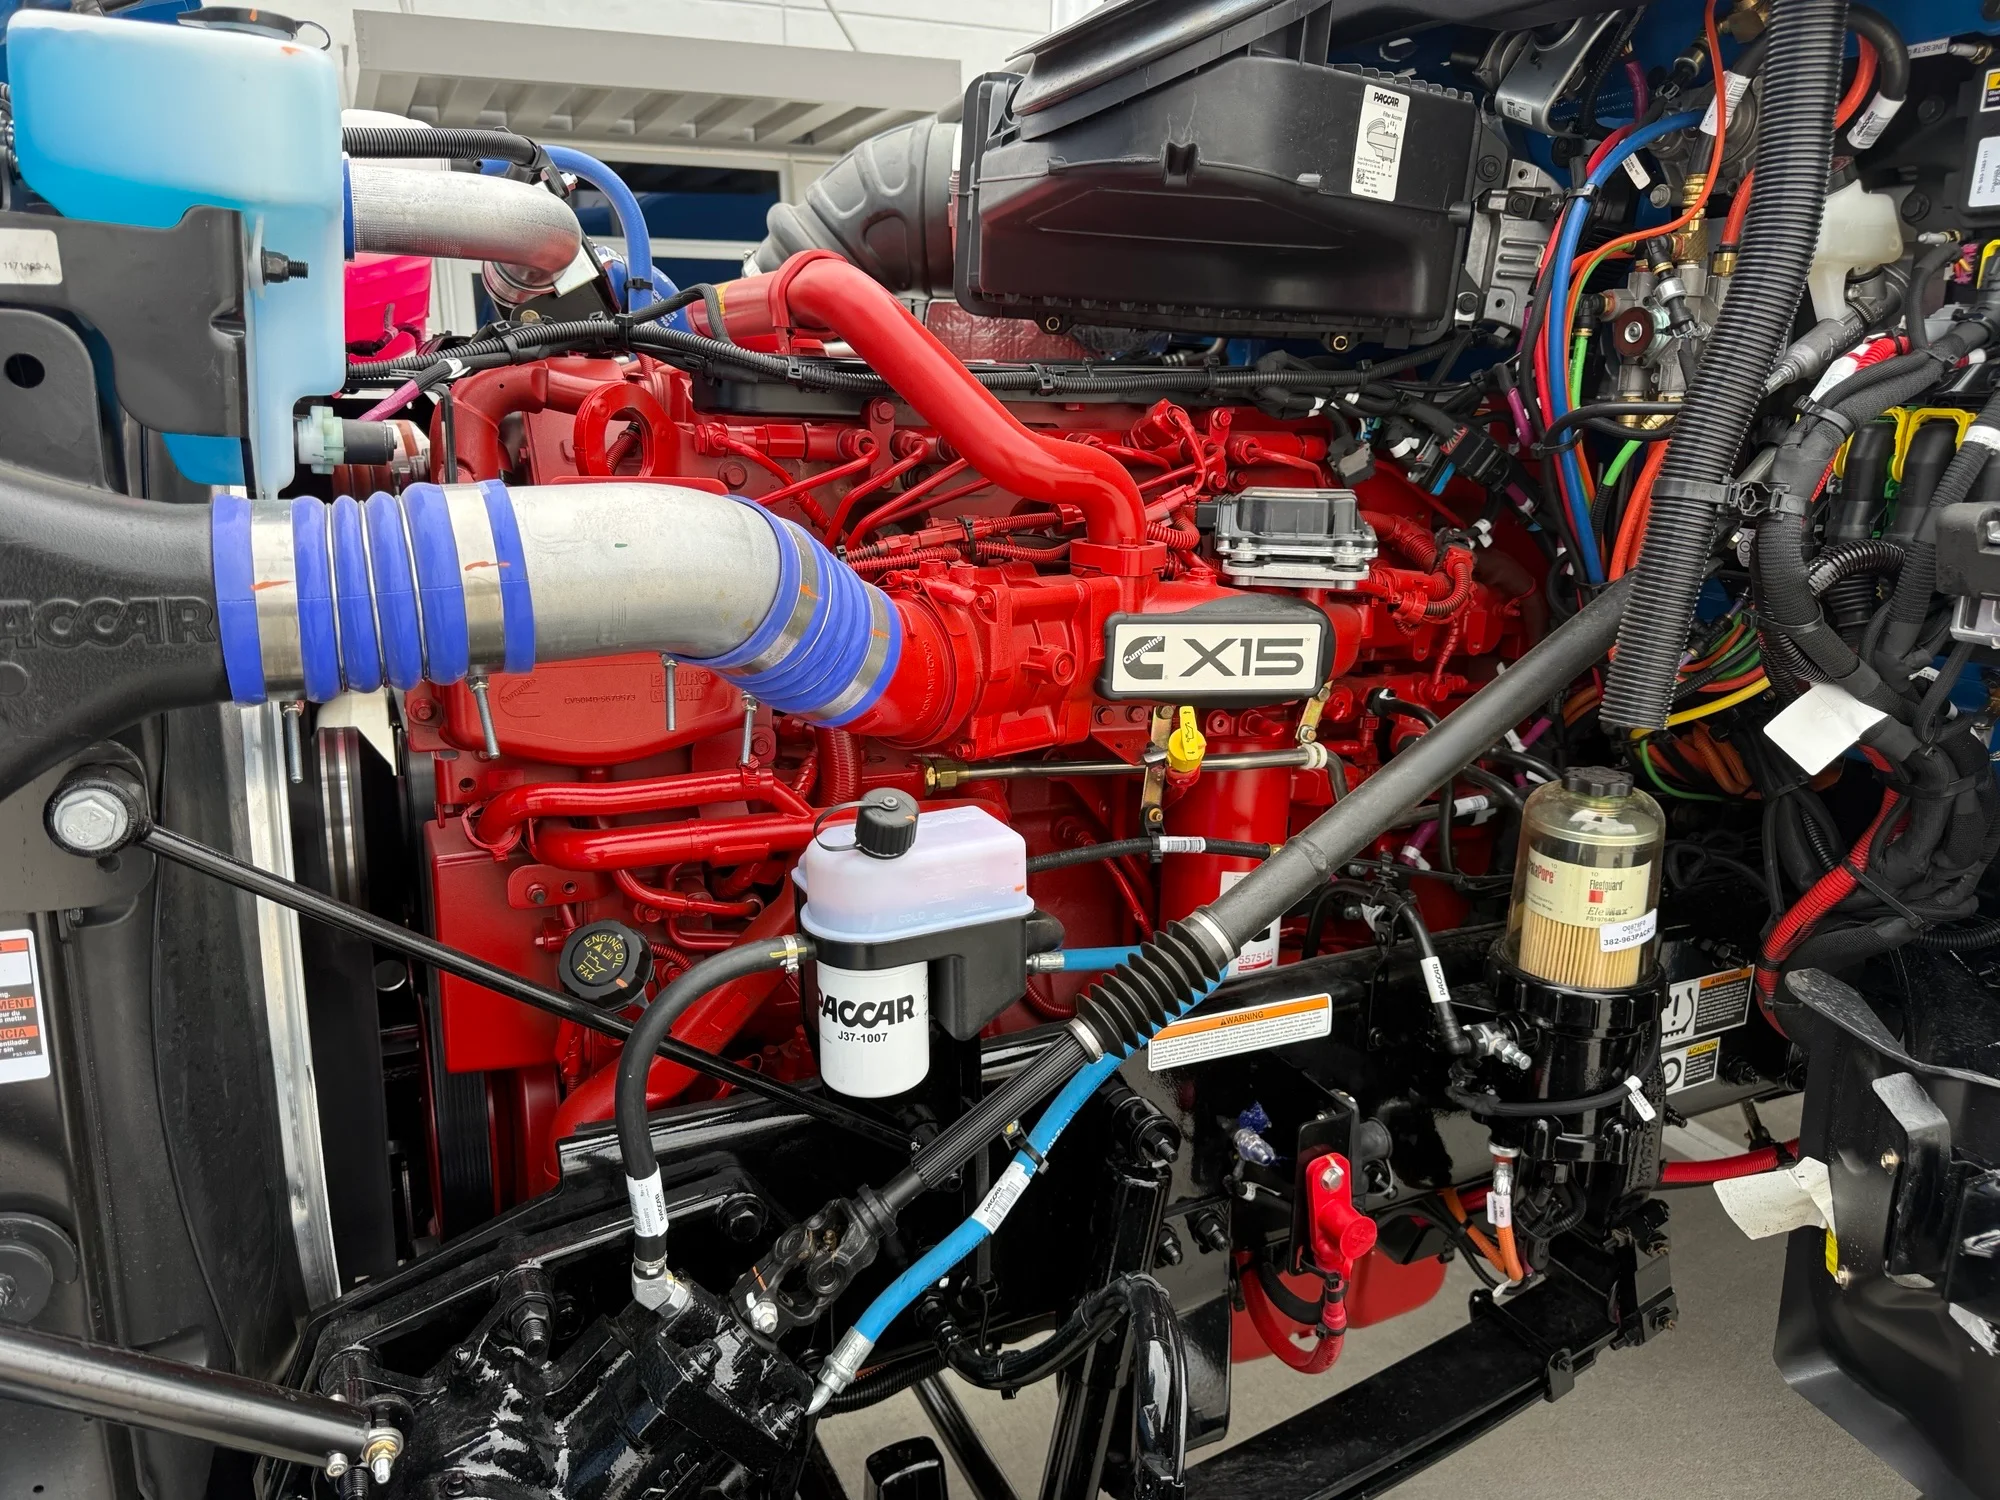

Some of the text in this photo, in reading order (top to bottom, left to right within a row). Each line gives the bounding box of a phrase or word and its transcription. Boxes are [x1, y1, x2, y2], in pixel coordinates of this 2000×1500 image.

[1374, 92, 1400, 108] PACCAR
[1123, 635, 1164, 665] Cummins
[1179, 638, 1304, 677] X15
[916, 640, 935, 721] MADE IN INDIA
[1589, 879, 1624, 892] Fleetguard
[584, 934, 624, 969] ENGINE OIL
[576, 964, 595, 980] FA4
[1432, 963, 1447, 996] PACCAR
[1225, 1010, 1264, 1026] WARNING
[837, 1031, 888, 1043] J37-1007
[1691, 1041, 1718, 1054] CAUTION
[654, 1193, 665, 1222] PACCAR
[984, 1186, 1002, 1213] PACCAR
